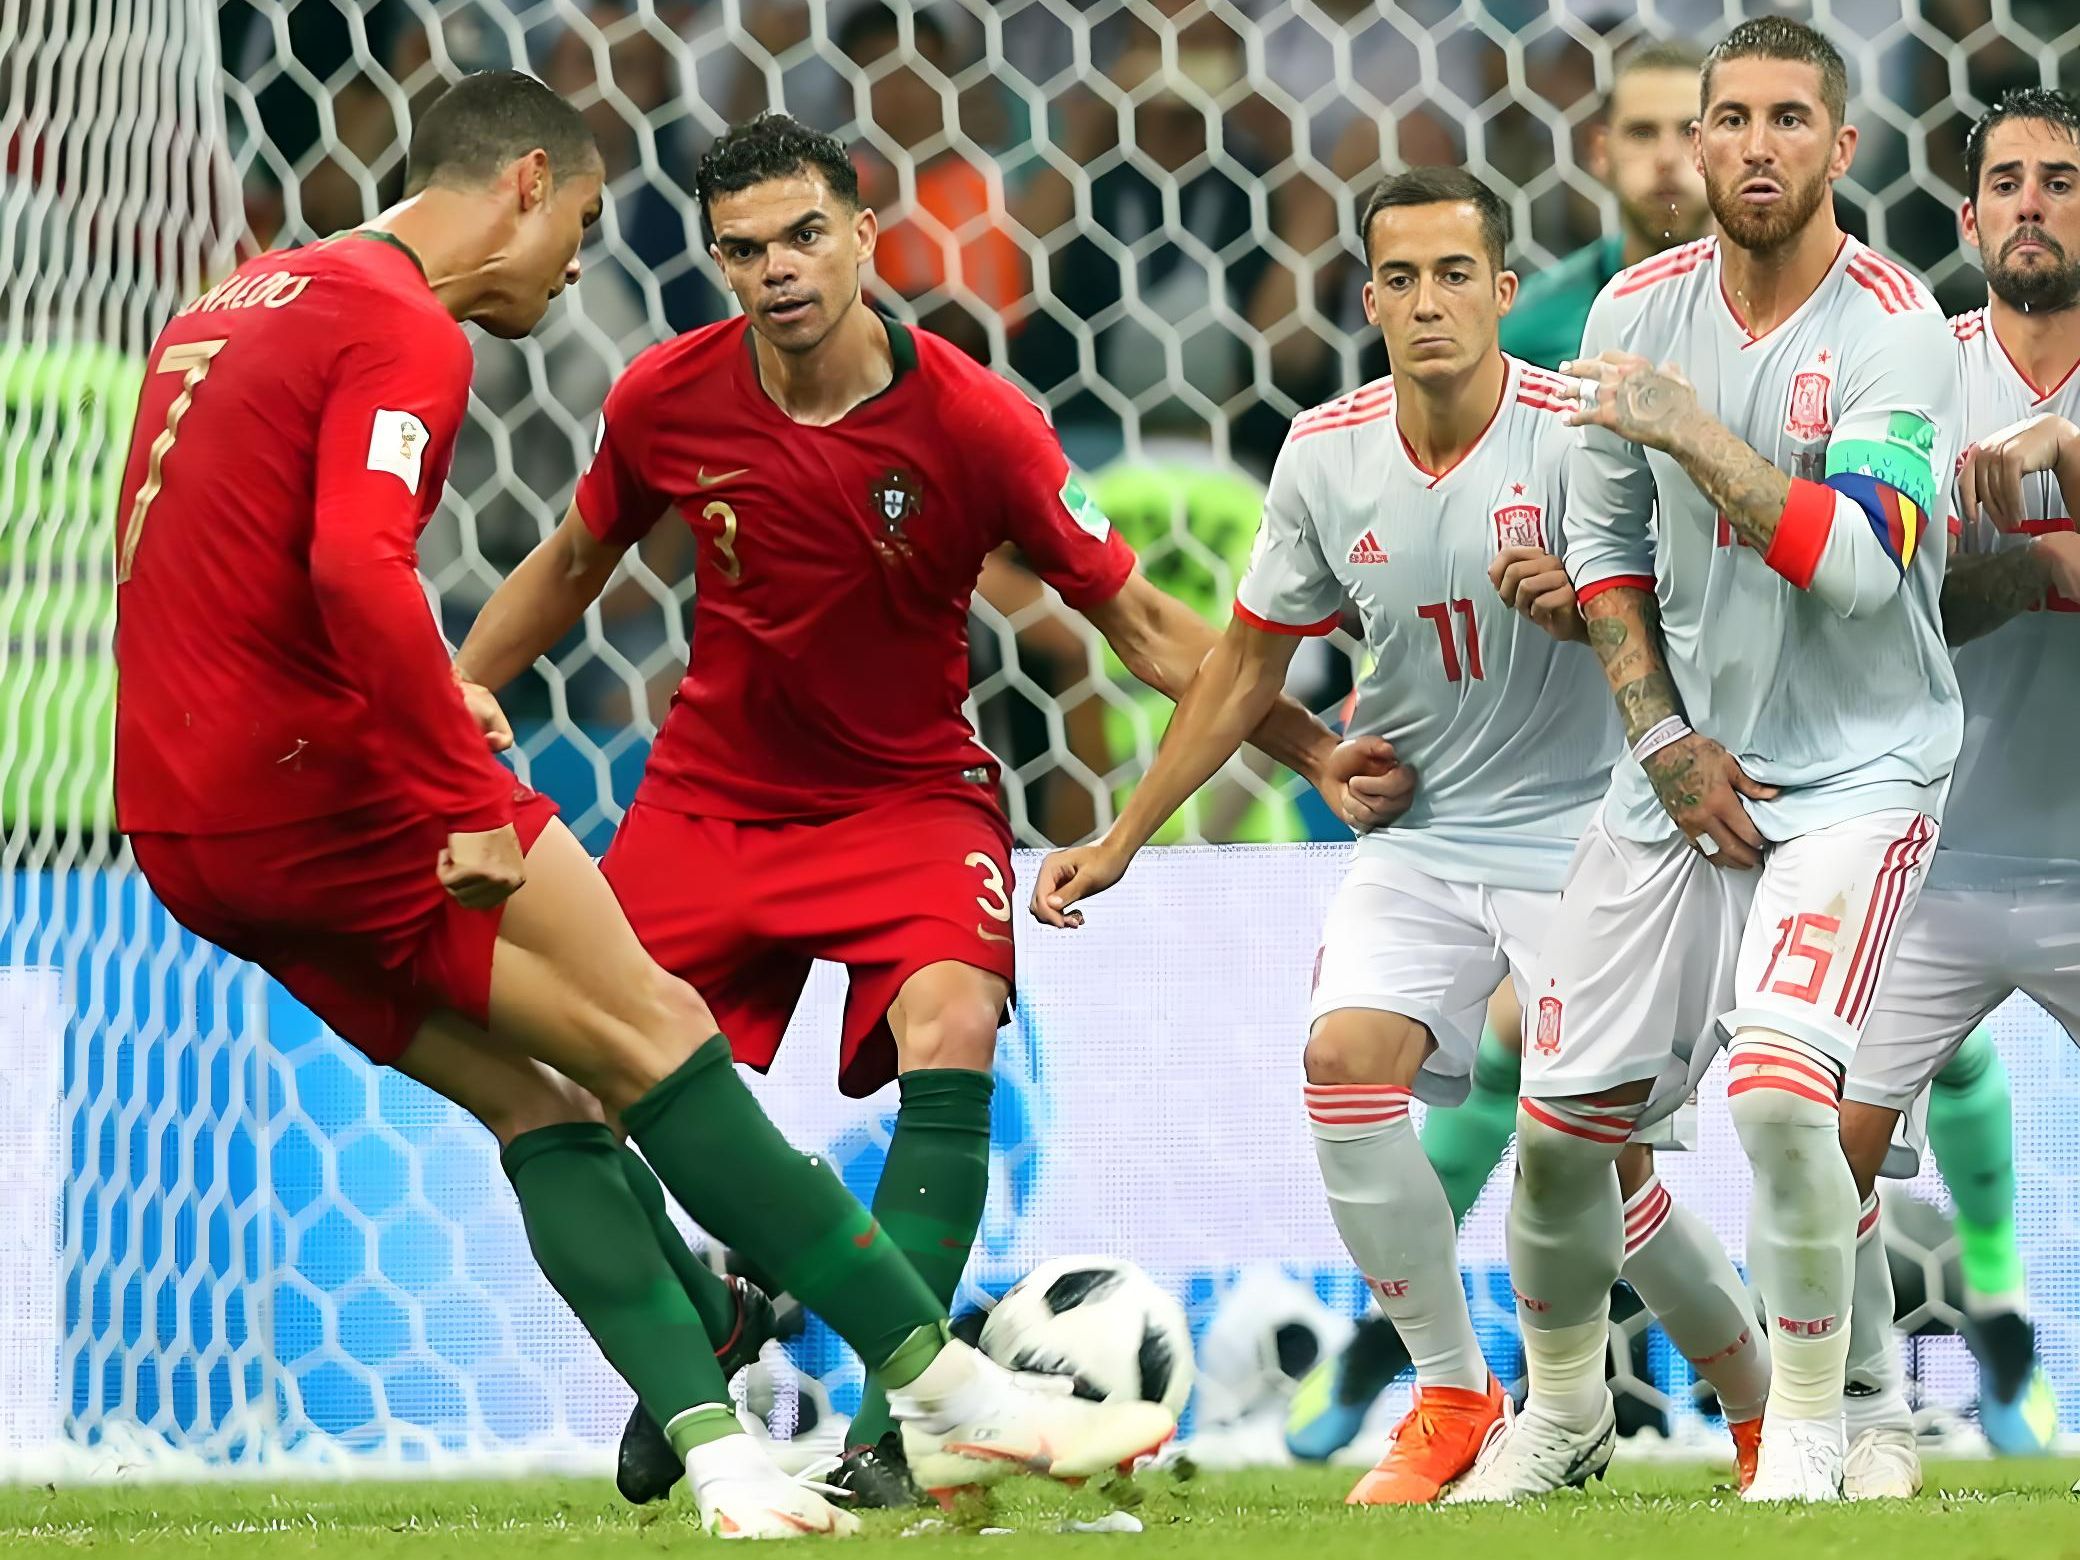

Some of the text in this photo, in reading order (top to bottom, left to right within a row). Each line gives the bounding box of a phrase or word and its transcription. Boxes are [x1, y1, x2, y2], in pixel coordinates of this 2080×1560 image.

[117, 338, 229, 585] 7
[702, 500, 741, 586] 3
[1417, 598, 1485, 682] 11
[964, 852, 1011, 922] 3
[1756, 913, 1841, 1005] 15
